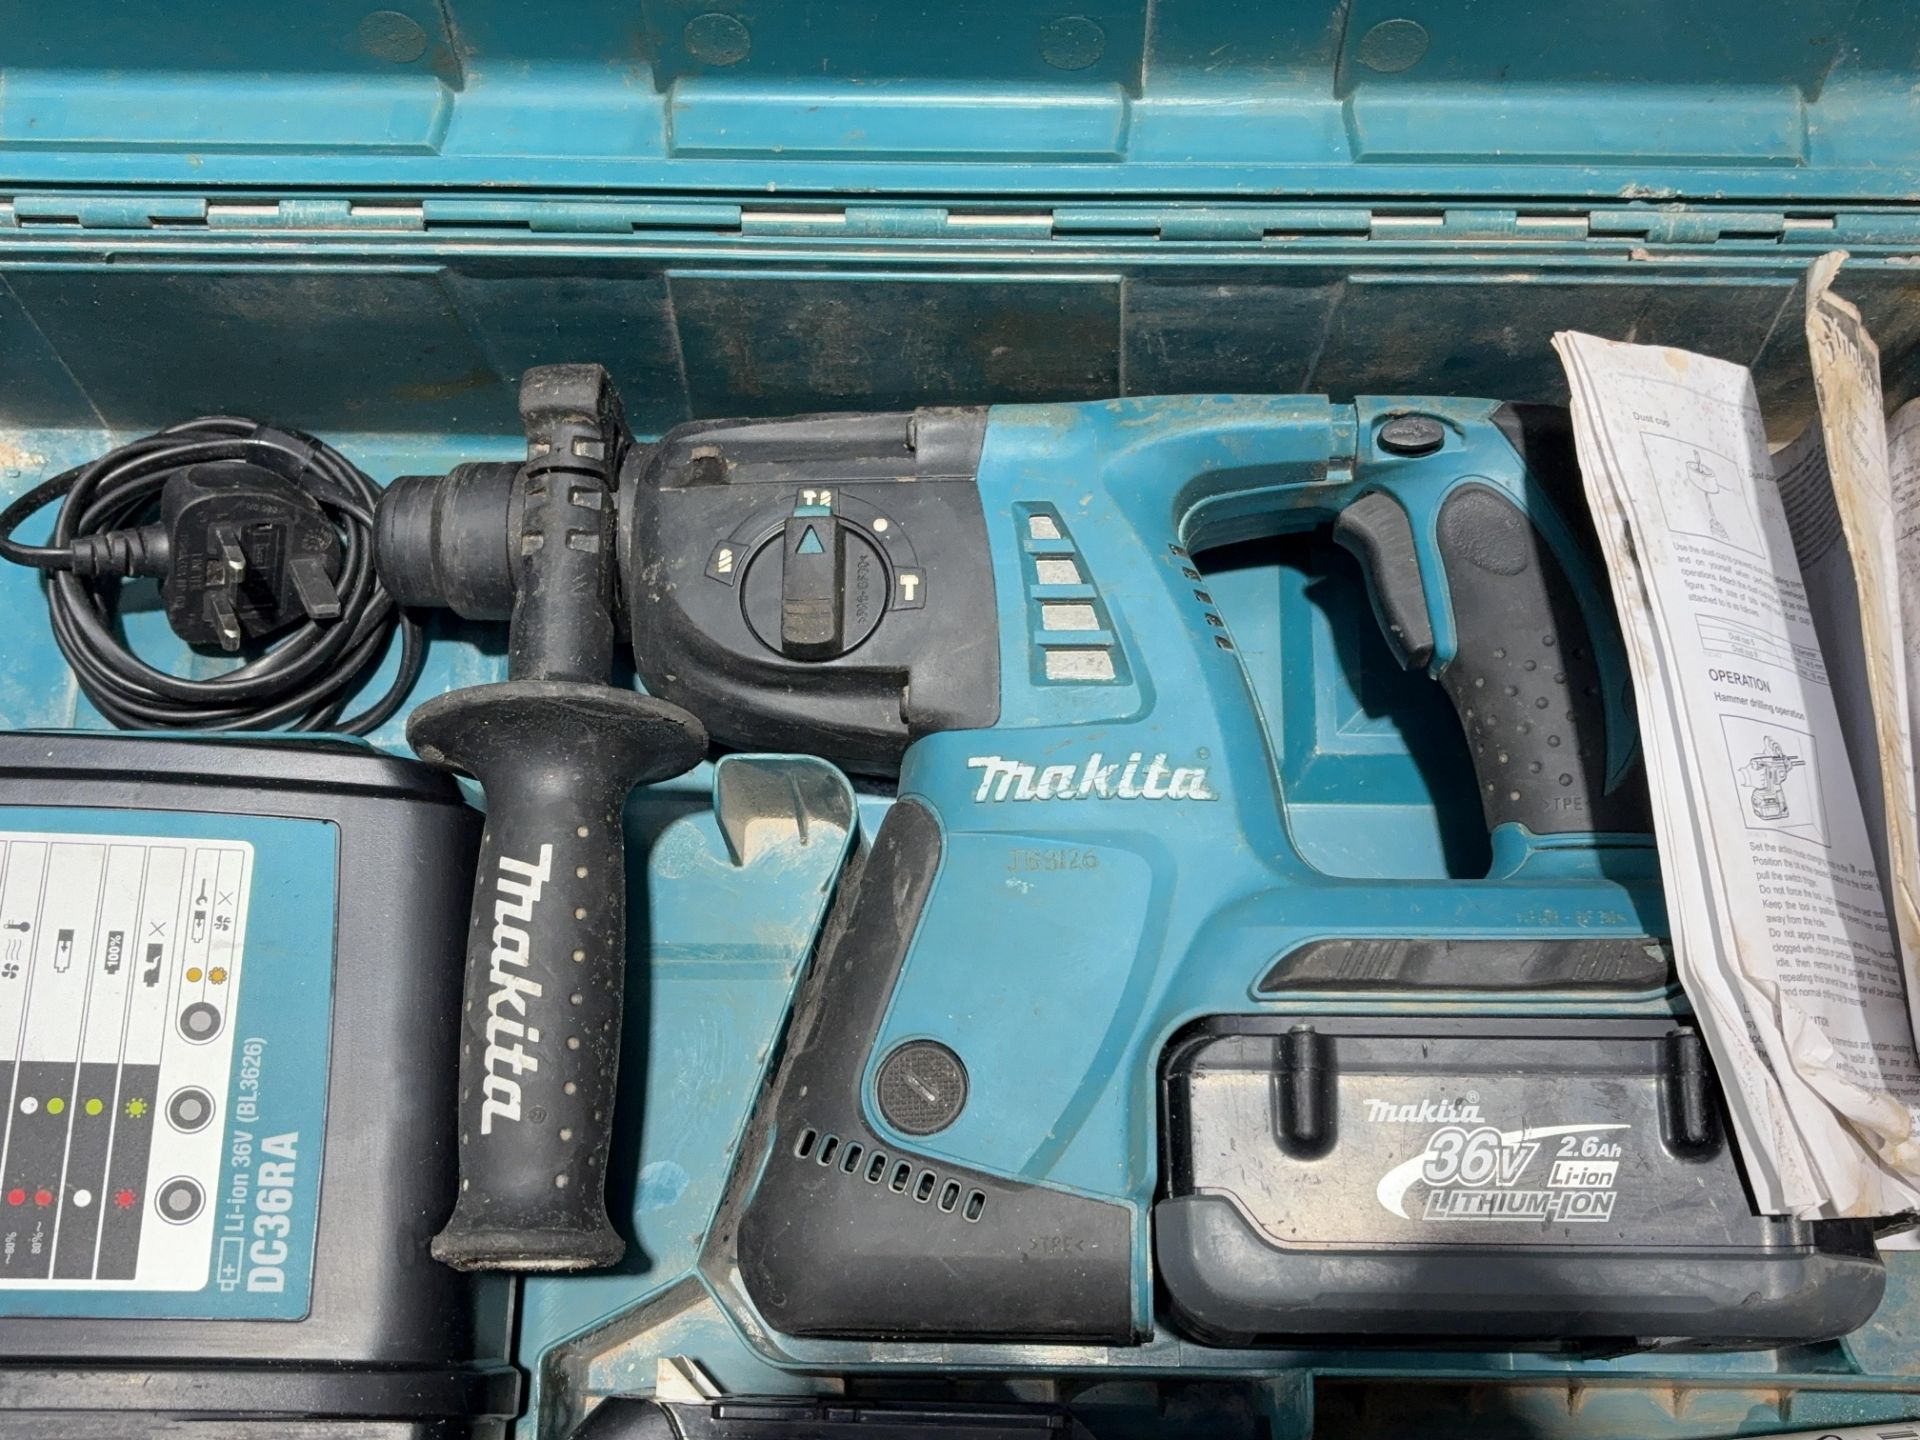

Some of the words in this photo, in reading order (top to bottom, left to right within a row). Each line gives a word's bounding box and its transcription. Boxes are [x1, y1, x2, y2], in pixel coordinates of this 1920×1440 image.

[1709, 668, 1771, 694] OPERATION
[1714, 691, 1749, 706] Hammer
[1768, 927, 1780, 938] Do
[105, 933, 123, 970] 100%
[236, 1037, 267, 1122] (BL3626)
[230, 1130, 253, 1168] 36V
[1421, 1126, 1540, 1187] 36V
[1550, 1162, 1613, 1187] Li-ion
[224, 1175, 250, 1232] Li-ion
[247, 1130, 299, 1293] DC36RA
[1423, 1189, 1617, 1222] LITHIUM-ION
